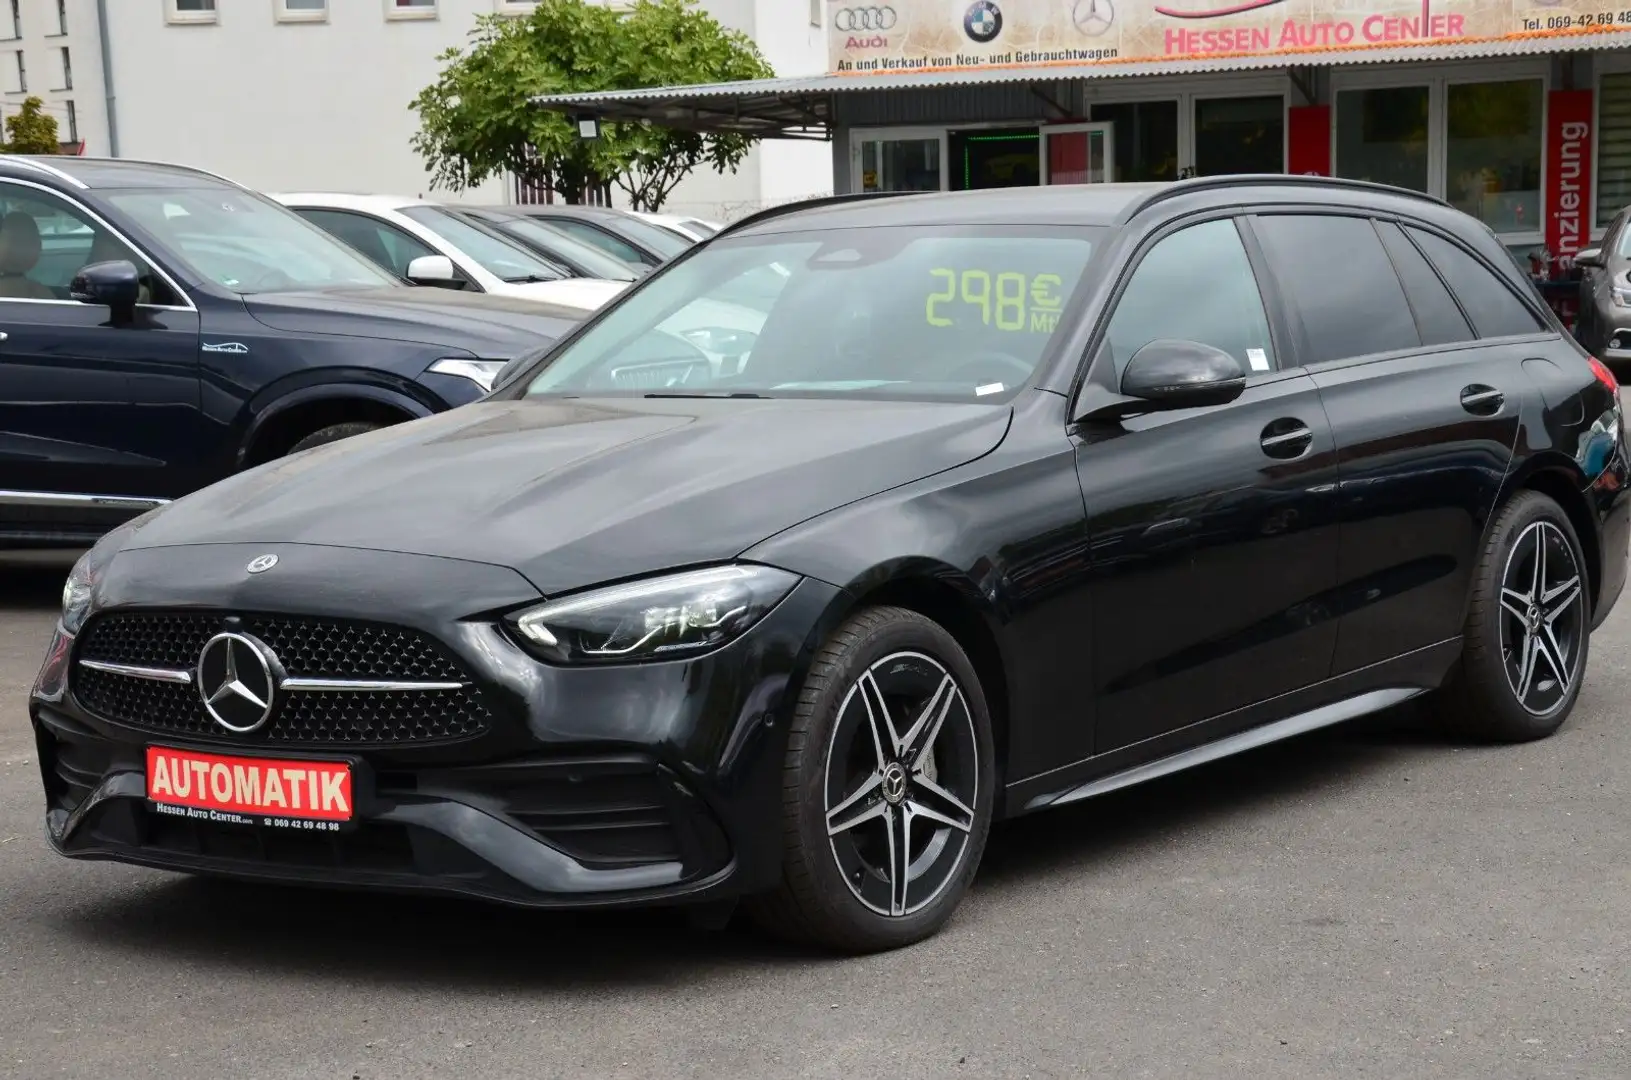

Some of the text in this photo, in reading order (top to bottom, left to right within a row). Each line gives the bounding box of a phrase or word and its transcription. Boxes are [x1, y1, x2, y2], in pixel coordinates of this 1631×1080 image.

[1522, 10, 1631, 31] Tel. 069-42 69 48
[1164, 27, 1270, 55] HESSEN
[1279, 19, 1355, 48] AUTO
[837, 48, 1118, 71] An und Verkauf von Neu- und Gebrauchtwagen
[152, 755, 349, 812] AUTOMATIK
[274, 818, 340, 831] 069 42 69 48 98
